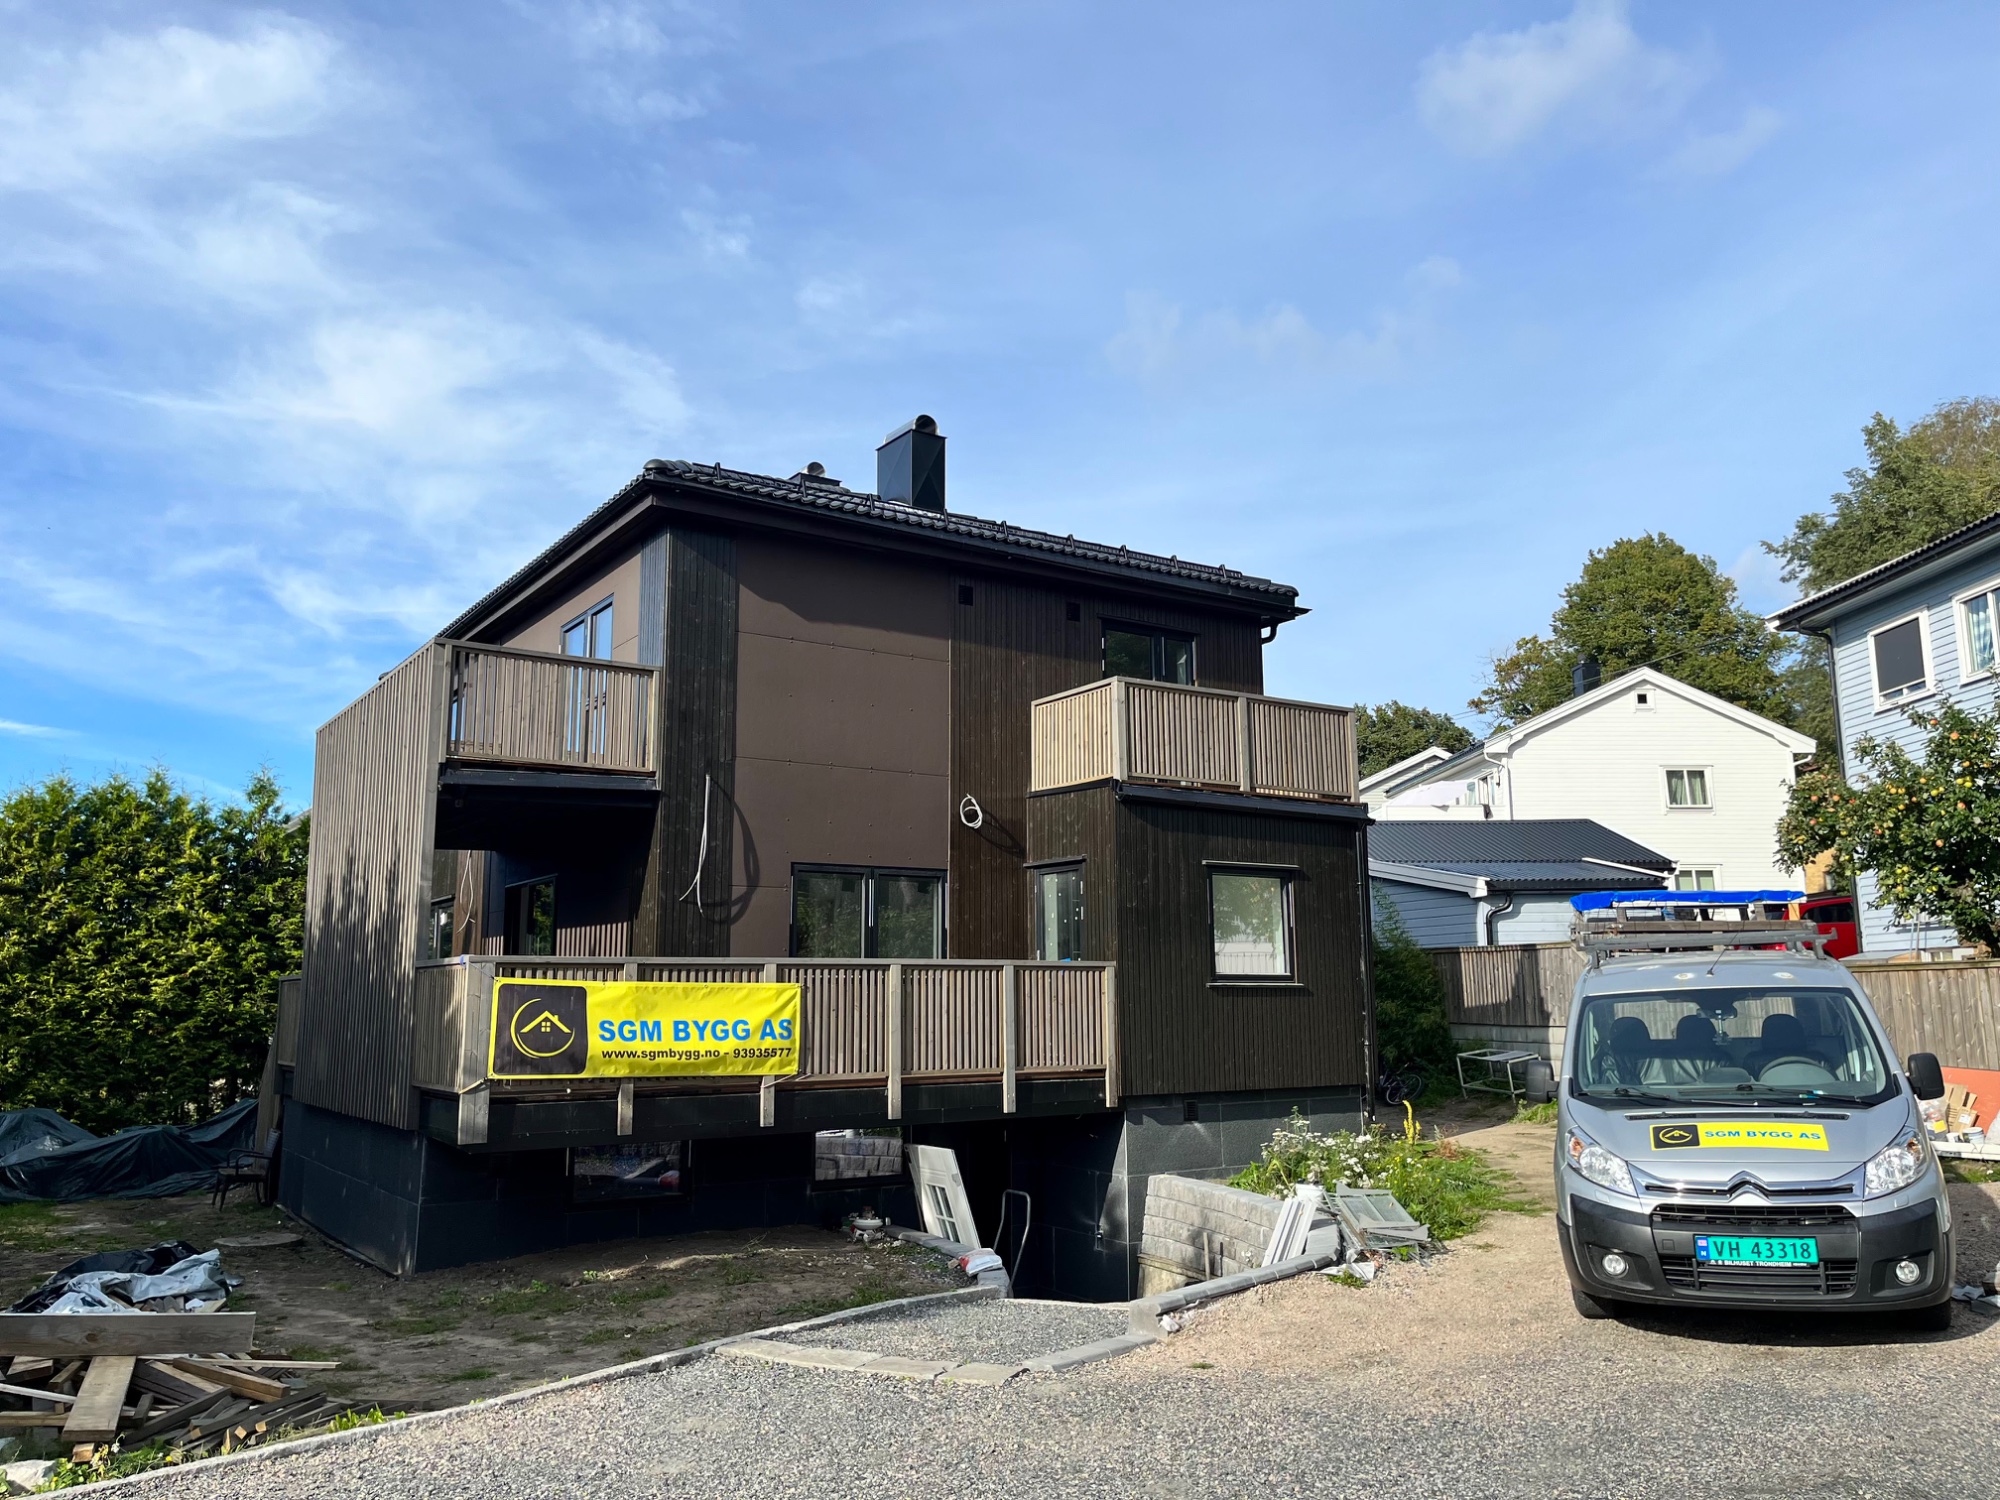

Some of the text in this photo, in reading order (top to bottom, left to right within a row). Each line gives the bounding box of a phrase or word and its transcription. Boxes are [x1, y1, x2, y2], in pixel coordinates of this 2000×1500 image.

[598, 1019, 793, 1042] SGM BYGG AS
[602, 1048, 721, 1061] www.sgmbygg.no
[733, 1047, 792, 1059] 93935577
[1713, 1240, 1811, 1259] VH 43318
